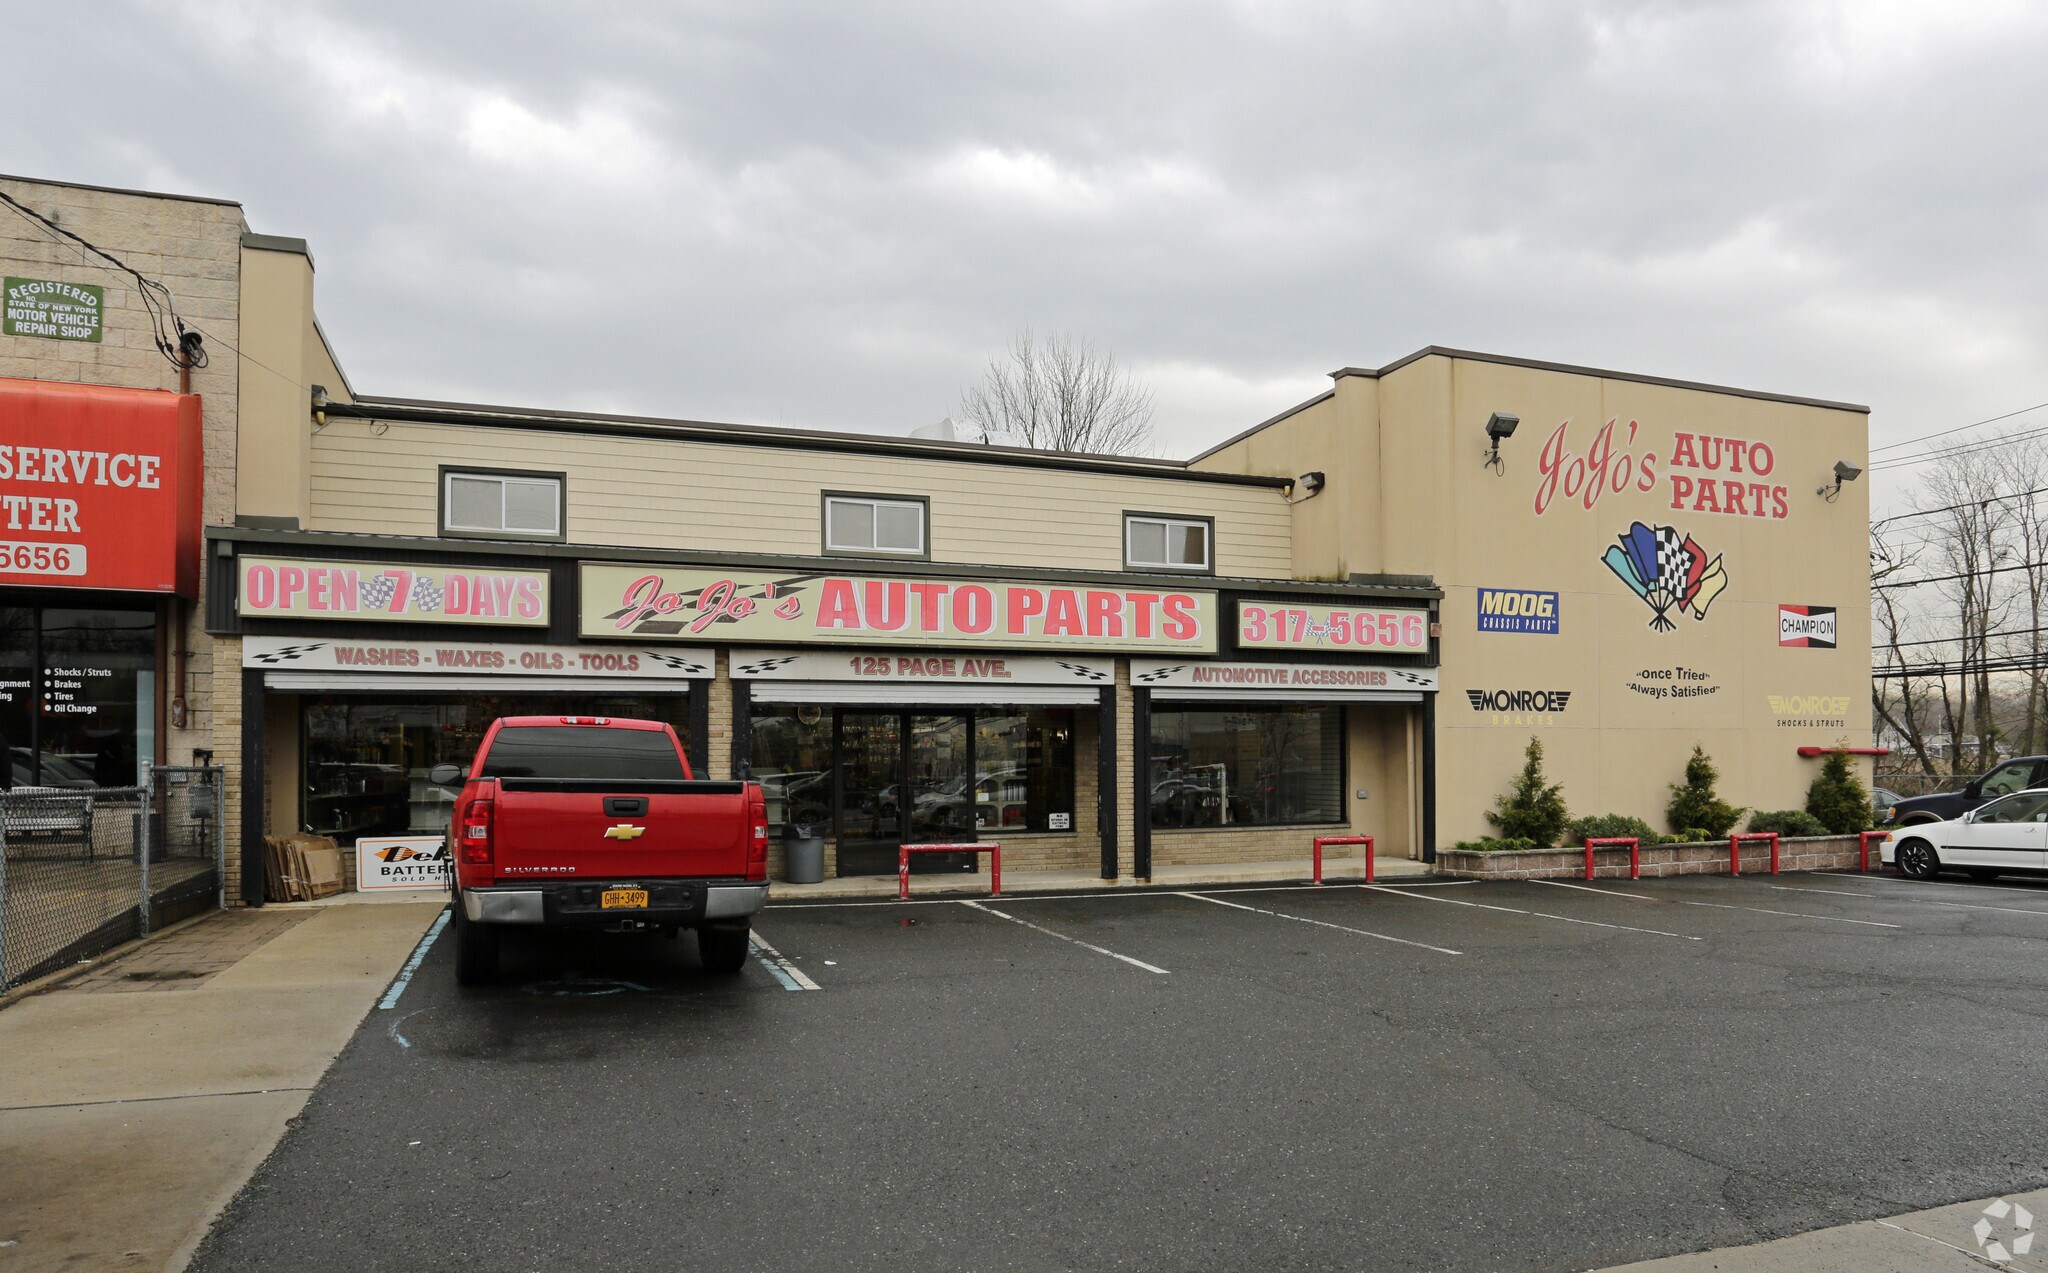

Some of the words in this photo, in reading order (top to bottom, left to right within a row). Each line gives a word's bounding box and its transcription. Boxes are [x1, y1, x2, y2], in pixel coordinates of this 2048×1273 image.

[8, 282, 98, 306] REGISTERED
[9, 300, 35, 308] STATE
[52, 304, 72, 312] NEW
[74, 306, 97, 314] YORK
[8, 308, 47, 322] MOTOR
[50, 312, 99, 327] VEHICLE
[16, 322, 57, 335] REPAIR
[61, 326, 92, 338] SHOP
[1670, 432, 1775, 476] AUTO
[0, 444, 160, 489] SERVICE
[1670, 475, 1789, 519] PARTS
[0, 495, 81, 533] TER
[246, 564, 359, 612] OPEN
[382, 569, 414, 614] 7
[443, 573, 543, 619] DAYS
[815, 577, 996, 636] AUTO
[1007, 587, 1201, 641] PARTS
[1480, 591, 1554, 617] MOOG
[1242, 607, 1423, 647] 317-5656
[1483, 617, 1520, 629] CHASSIS
[1781, 618, 1834, 634] CHAMPION
[334, 646, 420, 666] WASHES
[435, 649, 505, 668] WAXES
[520, 652, 564, 670] OILS
[579, 653, 640, 671] TOOLS
[849, 656, 891, 676] 125
[898, 658, 957, 677] PAGE
[961, 659, 1011, 679] AVE.
[54, 667, 81, 676] Shocks
[87, 668, 112, 676] Struts
[1192, 666, 1288, 685] AUTOMOTIVE
[1291, 668, 1387, 686] ACCESSORIES
[54, 680, 82, 688] Brakes
[54, 692, 74, 700] Tires
[1480, 690, 1559, 712] MONROE
[1780, 695, 1842, 715] MONROE
[54, 704, 66, 713] Oil
[67, 704, 97, 714] Change
[1492, 715, 1554, 725] BRAKES
[1777, 719, 1807, 727] SHOCKS
[1809, 719, 1814, 727] &
